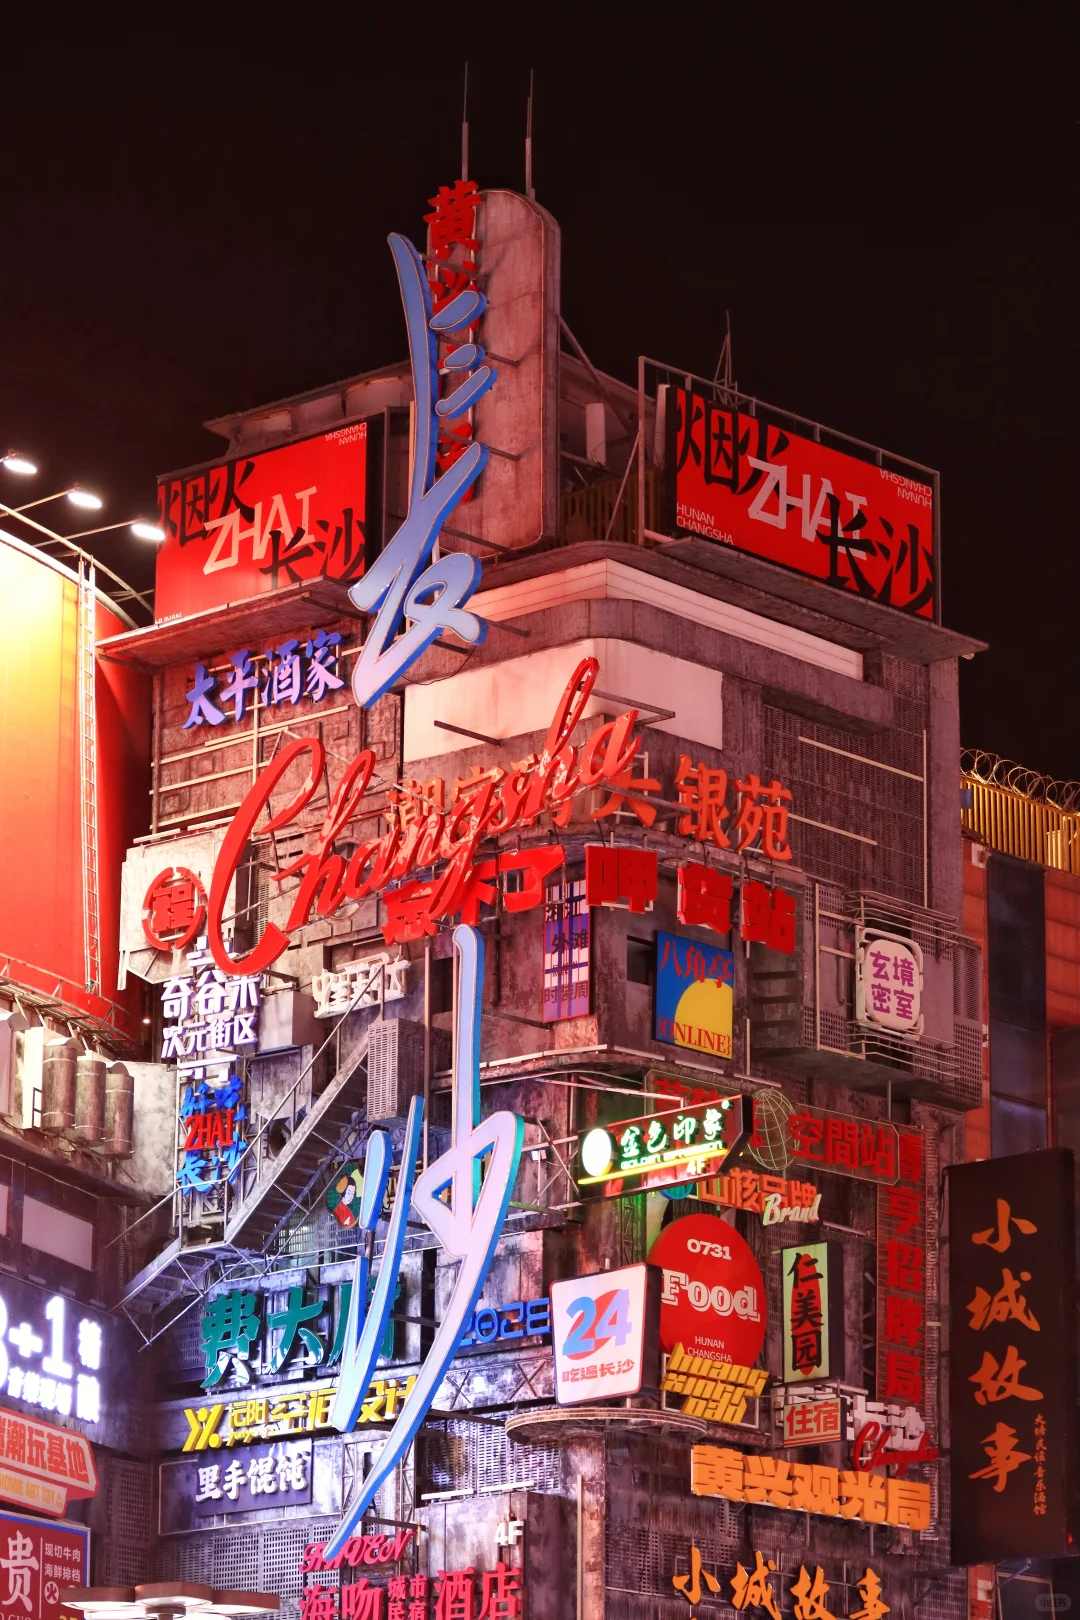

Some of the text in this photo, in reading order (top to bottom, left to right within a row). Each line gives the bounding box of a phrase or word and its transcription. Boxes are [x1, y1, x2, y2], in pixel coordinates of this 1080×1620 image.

[338, 430, 367, 446] HUNAN
[879, 467, 932, 497] CHANGSHA
[897, 486, 932, 509] HUNAN
[676, 503, 715, 526] HUNAN
[747, 455, 868, 561] ZHAI
[202, 485, 318, 575] ZHAI
[676, 515, 734, 546] CHANGSHA
[814, 492, 933, 612] 长沙
[182, 629, 345, 729] 太平酒家
[207, 656, 640, 974] Changsha
[551, 929, 589, 955] 外滩
[658, 941, 732, 988] 八角亭
[869, 950, 915, 988] 玄境
[543, 981, 589, 1004] 时装周
[870, 982, 915, 1021] 密室
[161, 1011, 259, 1060] 次元街区
[183, 1109, 236, 1151] ZHAI
[620, 1108, 723, 1158] 金色印象
[788, 1111, 896, 1178] 空間站
[686, 1157, 707, 1176] 4F
[763, 1193, 822, 1227] Brand
[686, 1238, 732, 1261] 0731
[660, 1269, 761, 1323] Food
[786, 1252, 824, 1373] 仁美园
[562, 1289, 633, 1356] 24
[687, 1347, 733, 1364] CHANGSHA
[694, 1335, 725, 1350] HUNAN
[968, 1198, 1044, 1493] 小城故事
[562, 1358, 635, 1383] 吃遍长沙
[785, 1401, 839, 1437] 住宿
[195, 1451, 311, 1504] 里手馄饨
[691, 1444, 931, 1531] 黄兴观光局
[44, 1542, 81, 1563] 现切牛肉
[494, 1520, 525, 1547] 4F
[0, 1530, 40, 1613] 贵
[44, 1563, 81, 1583] 海鲜排档
[672, 1545, 891, 1620] 小城故事
